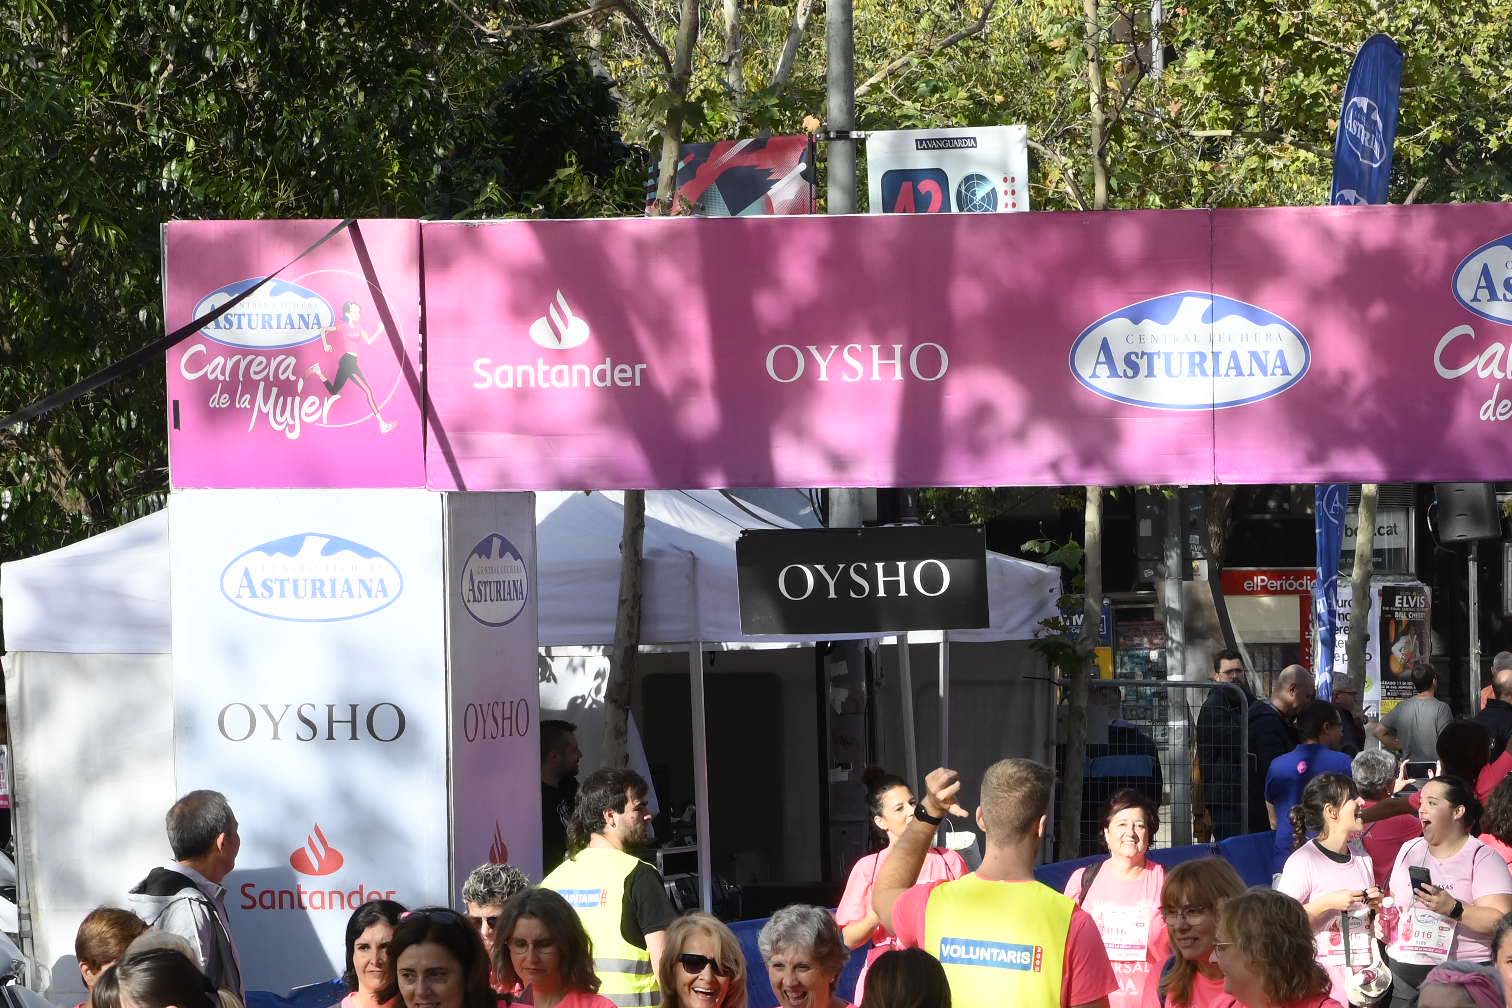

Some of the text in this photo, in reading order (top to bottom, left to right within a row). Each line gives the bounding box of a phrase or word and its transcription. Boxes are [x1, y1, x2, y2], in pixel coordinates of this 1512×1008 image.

[203, 303, 323, 330] ASTURIANA
[180, 343, 297, 381] Carrera
[472, 356, 647, 389] Santander
[765, 342, 949, 383] OYSHO
[1088, 336, 1292, 380] ASTURIANA
[209, 378, 342, 440] de la Mujer
[234, 566, 390, 599] ASTURIANA
[466, 569, 525, 604] ASTURIANA
[777, 558, 951, 601] OYSHO
[1394, 595, 1425, 608] ELVIS
[217, 701, 406, 742] OYSHO
[463, 698, 530, 743] OYSHO
[1414, 929, 1433, 939] 016
[940, 943, 1032, 965] VOLUNTARIS
